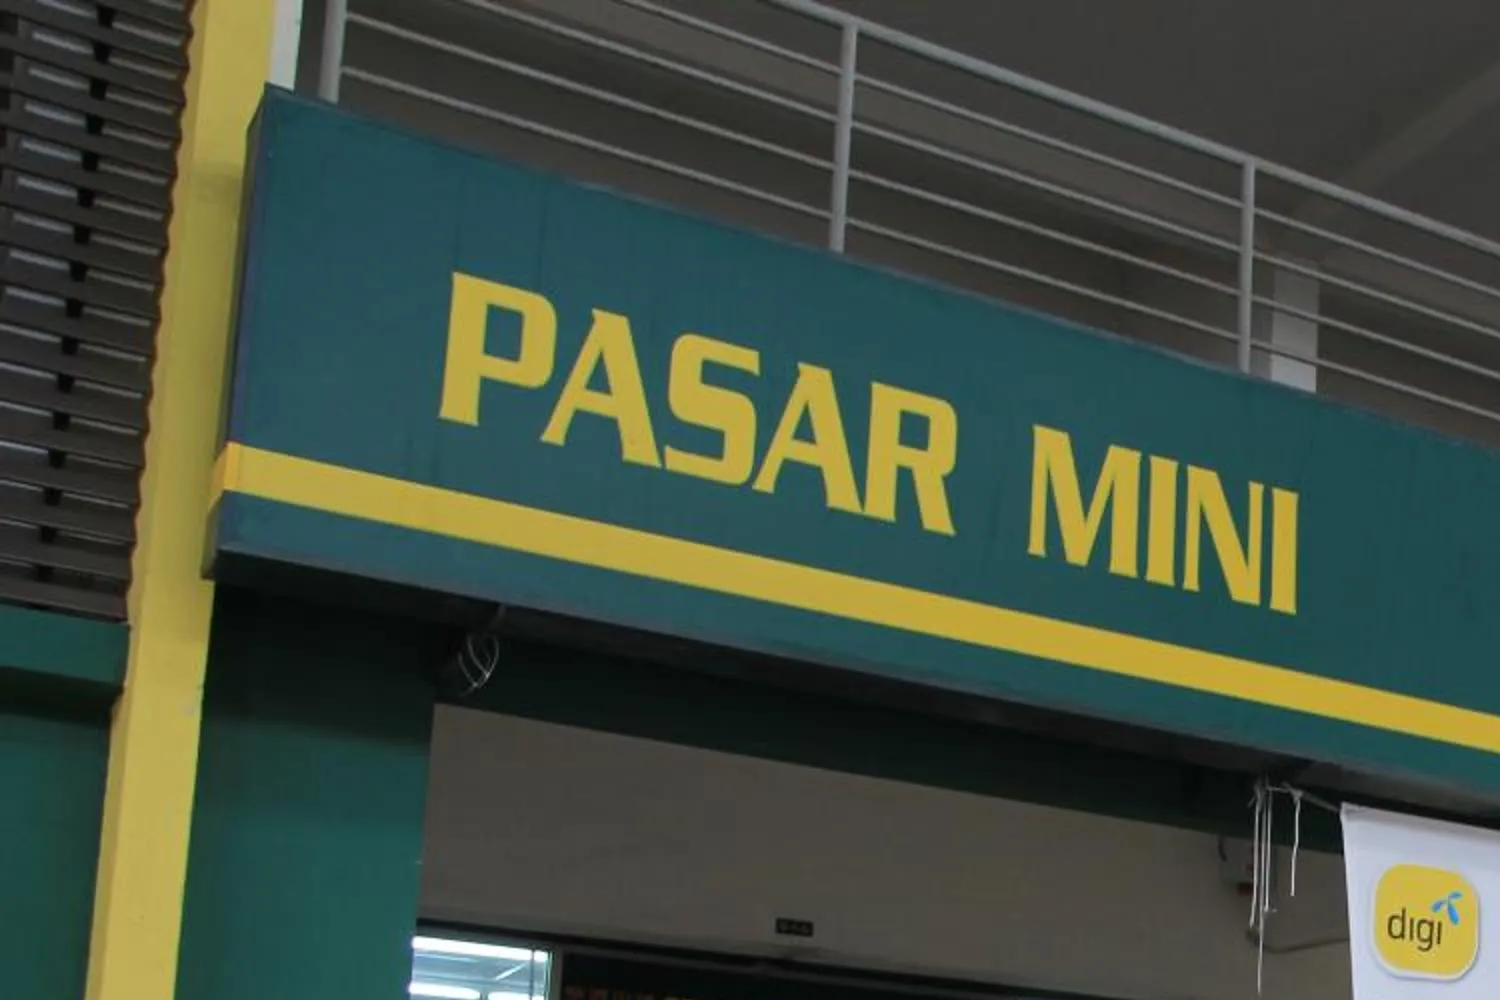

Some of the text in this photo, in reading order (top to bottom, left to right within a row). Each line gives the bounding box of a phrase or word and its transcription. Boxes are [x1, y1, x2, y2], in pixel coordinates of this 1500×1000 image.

[439, 272, 1299, 615] PASAR MINI
[1387, 907, 1443, 953] digi
